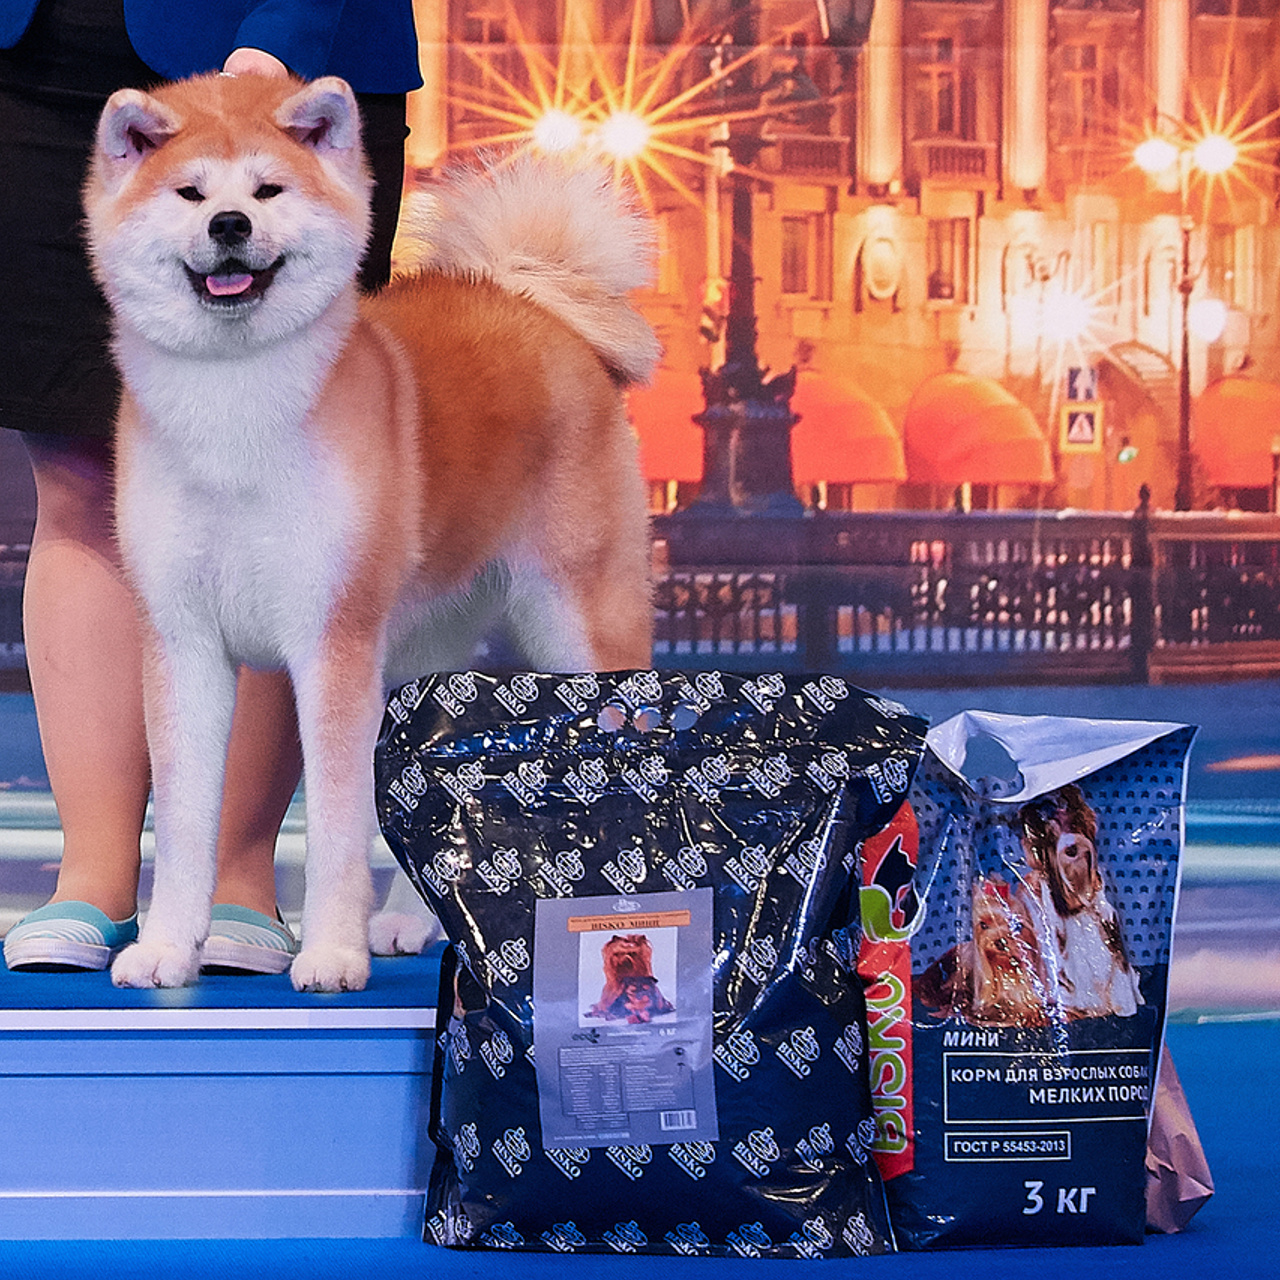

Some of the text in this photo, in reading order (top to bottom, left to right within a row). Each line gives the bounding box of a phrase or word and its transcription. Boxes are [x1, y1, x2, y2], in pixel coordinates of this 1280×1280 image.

[435, 684, 465, 716] BISKO
[496, 684, 526, 715] BISKO
[556, 682, 588, 713] BISKO
[804, 682, 836, 711] BISKO
[442, 772, 471, 802] BISKO
[503, 772, 536, 805] BISKO
[564, 770, 598, 803] BISKO
[624, 768, 658, 803] BISKO
[685, 766, 720, 800] BISKO
[748, 767, 781, 797] BISKO
[806, 761, 837, 790] BISKO
[865, 764, 893, 803] BISKO
[390, 779, 420, 811] BISKO
[422, 864, 450, 896] BISKO
[478, 860, 510, 894] BISKO
[540, 861, 574, 895] BISKO
[602, 860, 636, 894] BISKO
[664, 858, 696, 892] BISKO
[725, 856, 759, 892] BISKO
[591, 920, 625, 930] BISKO
[486, 950, 518, 984] BISKO
[738, 951, 766, 982] BISKO
[834, 1036, 858, 1070] BISKO
[943, 1031, 999, 1047] МИНИ
[480, 1040, 506, 1078] BISKO
[714, 1042, 750, 1080] BISKO
[778, 1040, 811, 1077] BISKO
[866, 971, 907, 1154] BISKO
[951, 1069, 1000, 1082] КОРМ
[1005, 1068, 1038, 1084] ДЛЯ
[1043, 1066, 1116, 1082] ВЗРОСЛЫХ
[1029, 1087, 1104, 1104] МЕЛКИХ
[493, 1138, 522, 1176] BISKO
[549, 1148, 581, 1178] ISKO
[608, 1145, 643, 1178] BISKO
[670, 1142, 706, 1179] BISKO
[734, 1140, 770, 1178] BISKO
[797, 1137, 824, 1170] BISKO
[954, 1141, 988, 1153] ГОСТ
[1002, 1140, 1066, 1152] 55453-2013
[1022, 1181, 1044, 1214] 3
